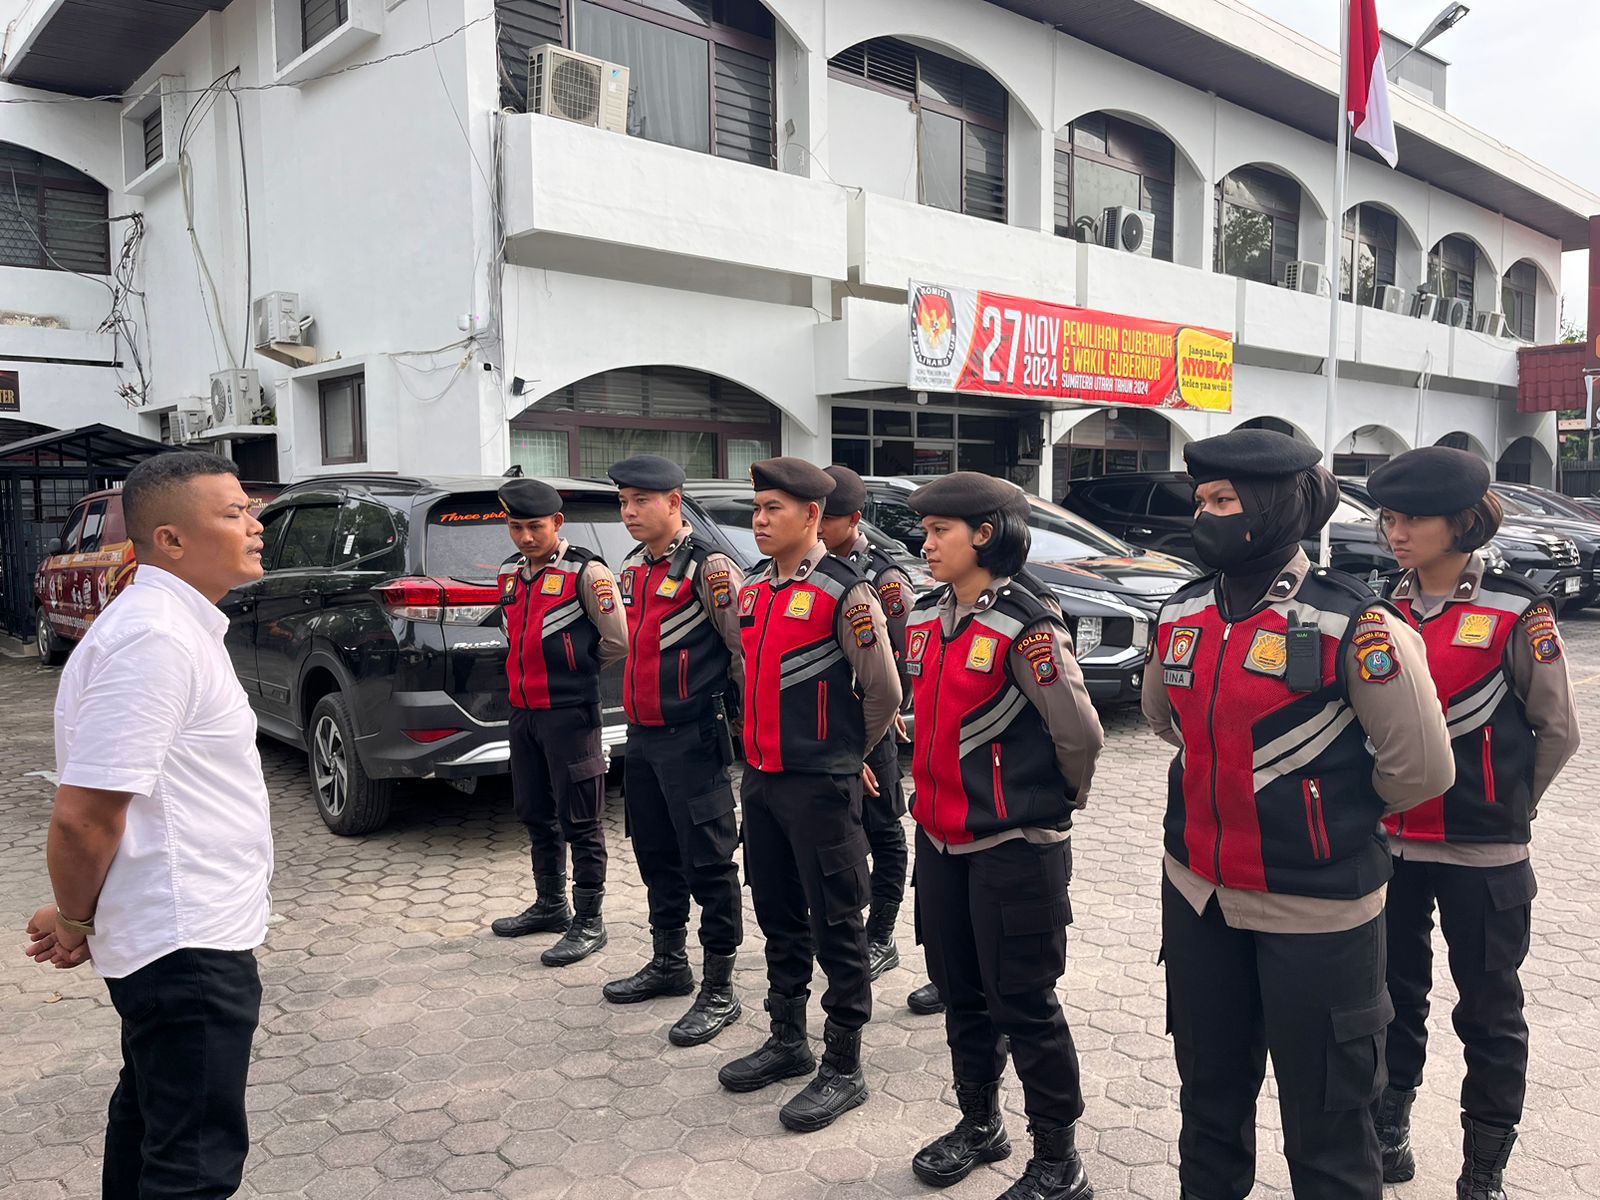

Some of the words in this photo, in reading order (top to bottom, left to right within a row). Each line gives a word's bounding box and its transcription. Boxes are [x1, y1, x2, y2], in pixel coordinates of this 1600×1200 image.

[983, 306, 1022, 384] 27
[1024, 313, 1060, 356] NOV
[1063, 319, 1119, 351] PEMILIHAN
[1121, 328, 1173, 358] GUBERNUR
[1023, 355, 1058, 388] 2024
[1062, 346, 1070, 372] &
[1073, 346, 1105, 378] WAKIL
[1109, 351, 1161, 380] GUBERNUR
[1061, 373, 1093, 390] SUMATERA
[1094, 376, 1113, 392] UTARA
[1115, 379, 1133, 393] TAHUN
[1133, 381, 1148, 395] 2024
[440, 512, 481, 523] Three
[707, 571, 728, 581] POLDA
[879, 582, 900, 594] POLDA
[846, 604, 869, 618] POLDA
[1357, 611, 1382, 622] LDA
[1017, 633, 1050, 651] POLDA
